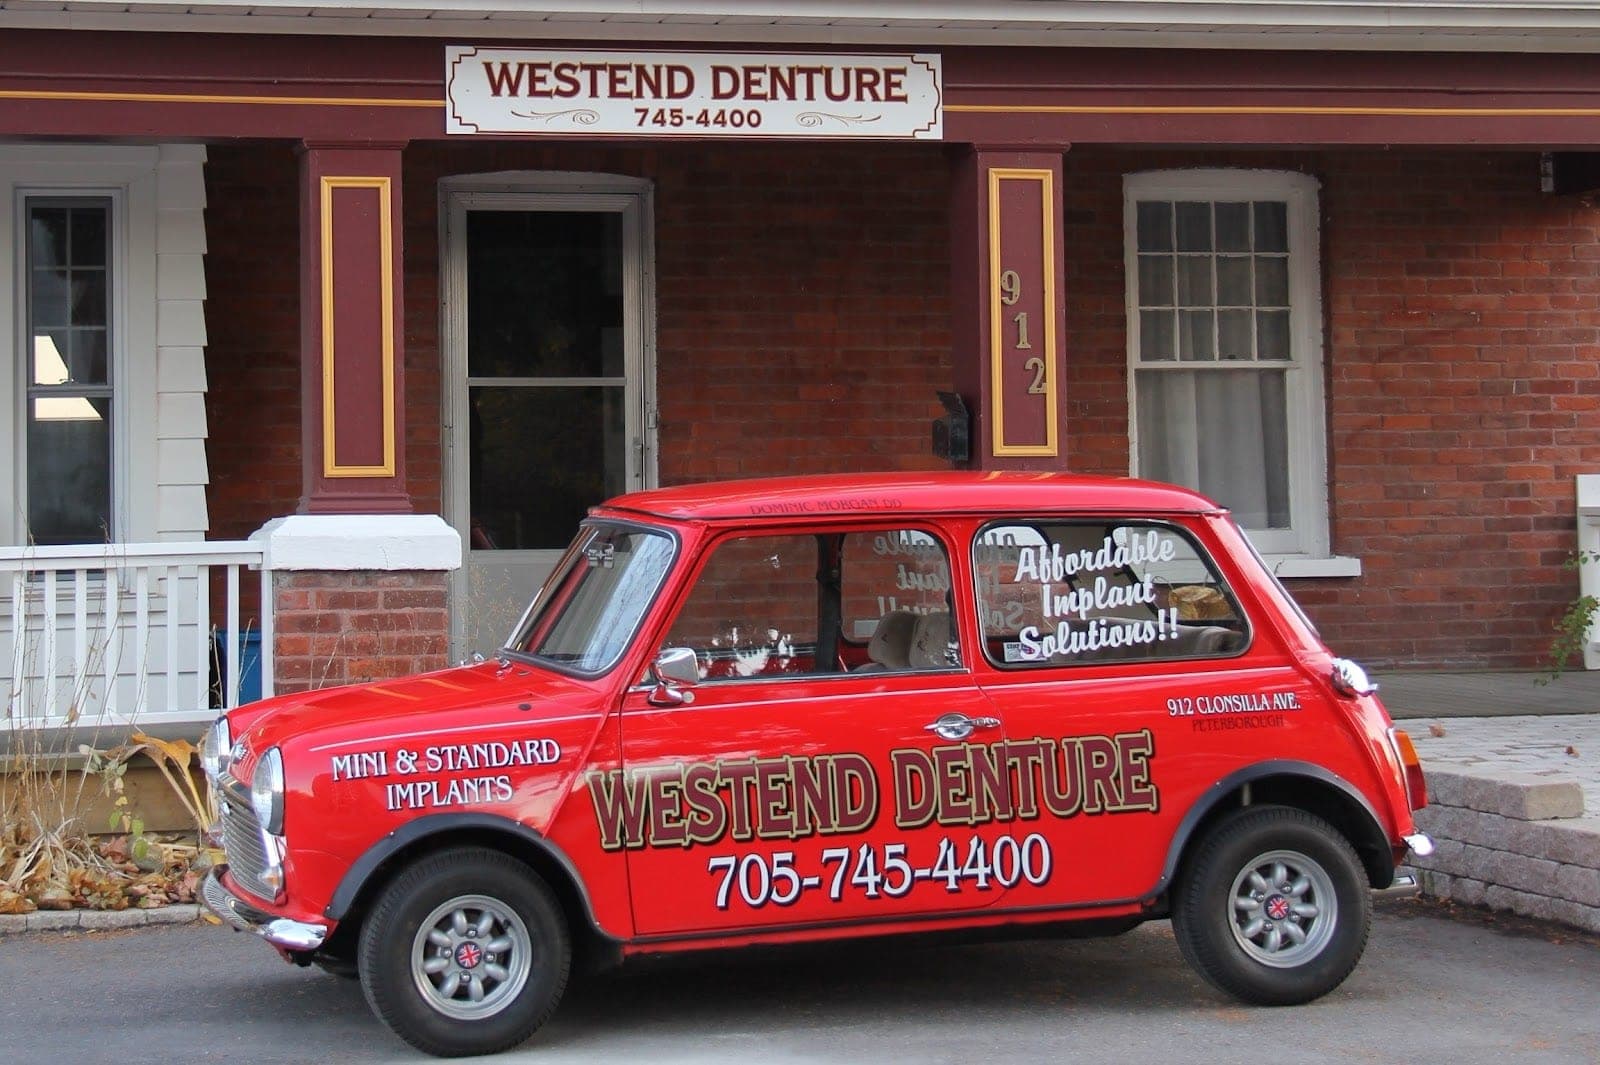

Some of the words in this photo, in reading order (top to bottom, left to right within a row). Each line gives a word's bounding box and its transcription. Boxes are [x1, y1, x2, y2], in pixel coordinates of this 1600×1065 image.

[483, 62, 695, 99] WESTEND
[711, 65, 908, 102] DENTURE
[634, 108, 762, 128] 745-4400
[751, 501, 814, 515] DOMINIC
[816, 498, 878, 512] MORGAN
[1014, 531, 1175, 583] Affordable
[1043, 574, 1156, 620] Implant
[1019, 607, 1179, 661] Solutions!!
[1167, 697, 1194, 716] 912
[1196, 693, 1270, 714] CLONSILLA
[1273, 692, 1301, 710] AVE.
[1192, 714, 1284, 732] PETERBOROUGH
[332, 751, 388, 781] MINI
[395, 749, 418, 775] &
[426, 739, 561, 772] STANDARD
[386, 776, 513, 810] IMPLANTS
[586, 752, 881, 852] WESTEND
[891, 728, 1160, 829] DENTURE
[708, 832, 1053, 909] 705-745-4400
